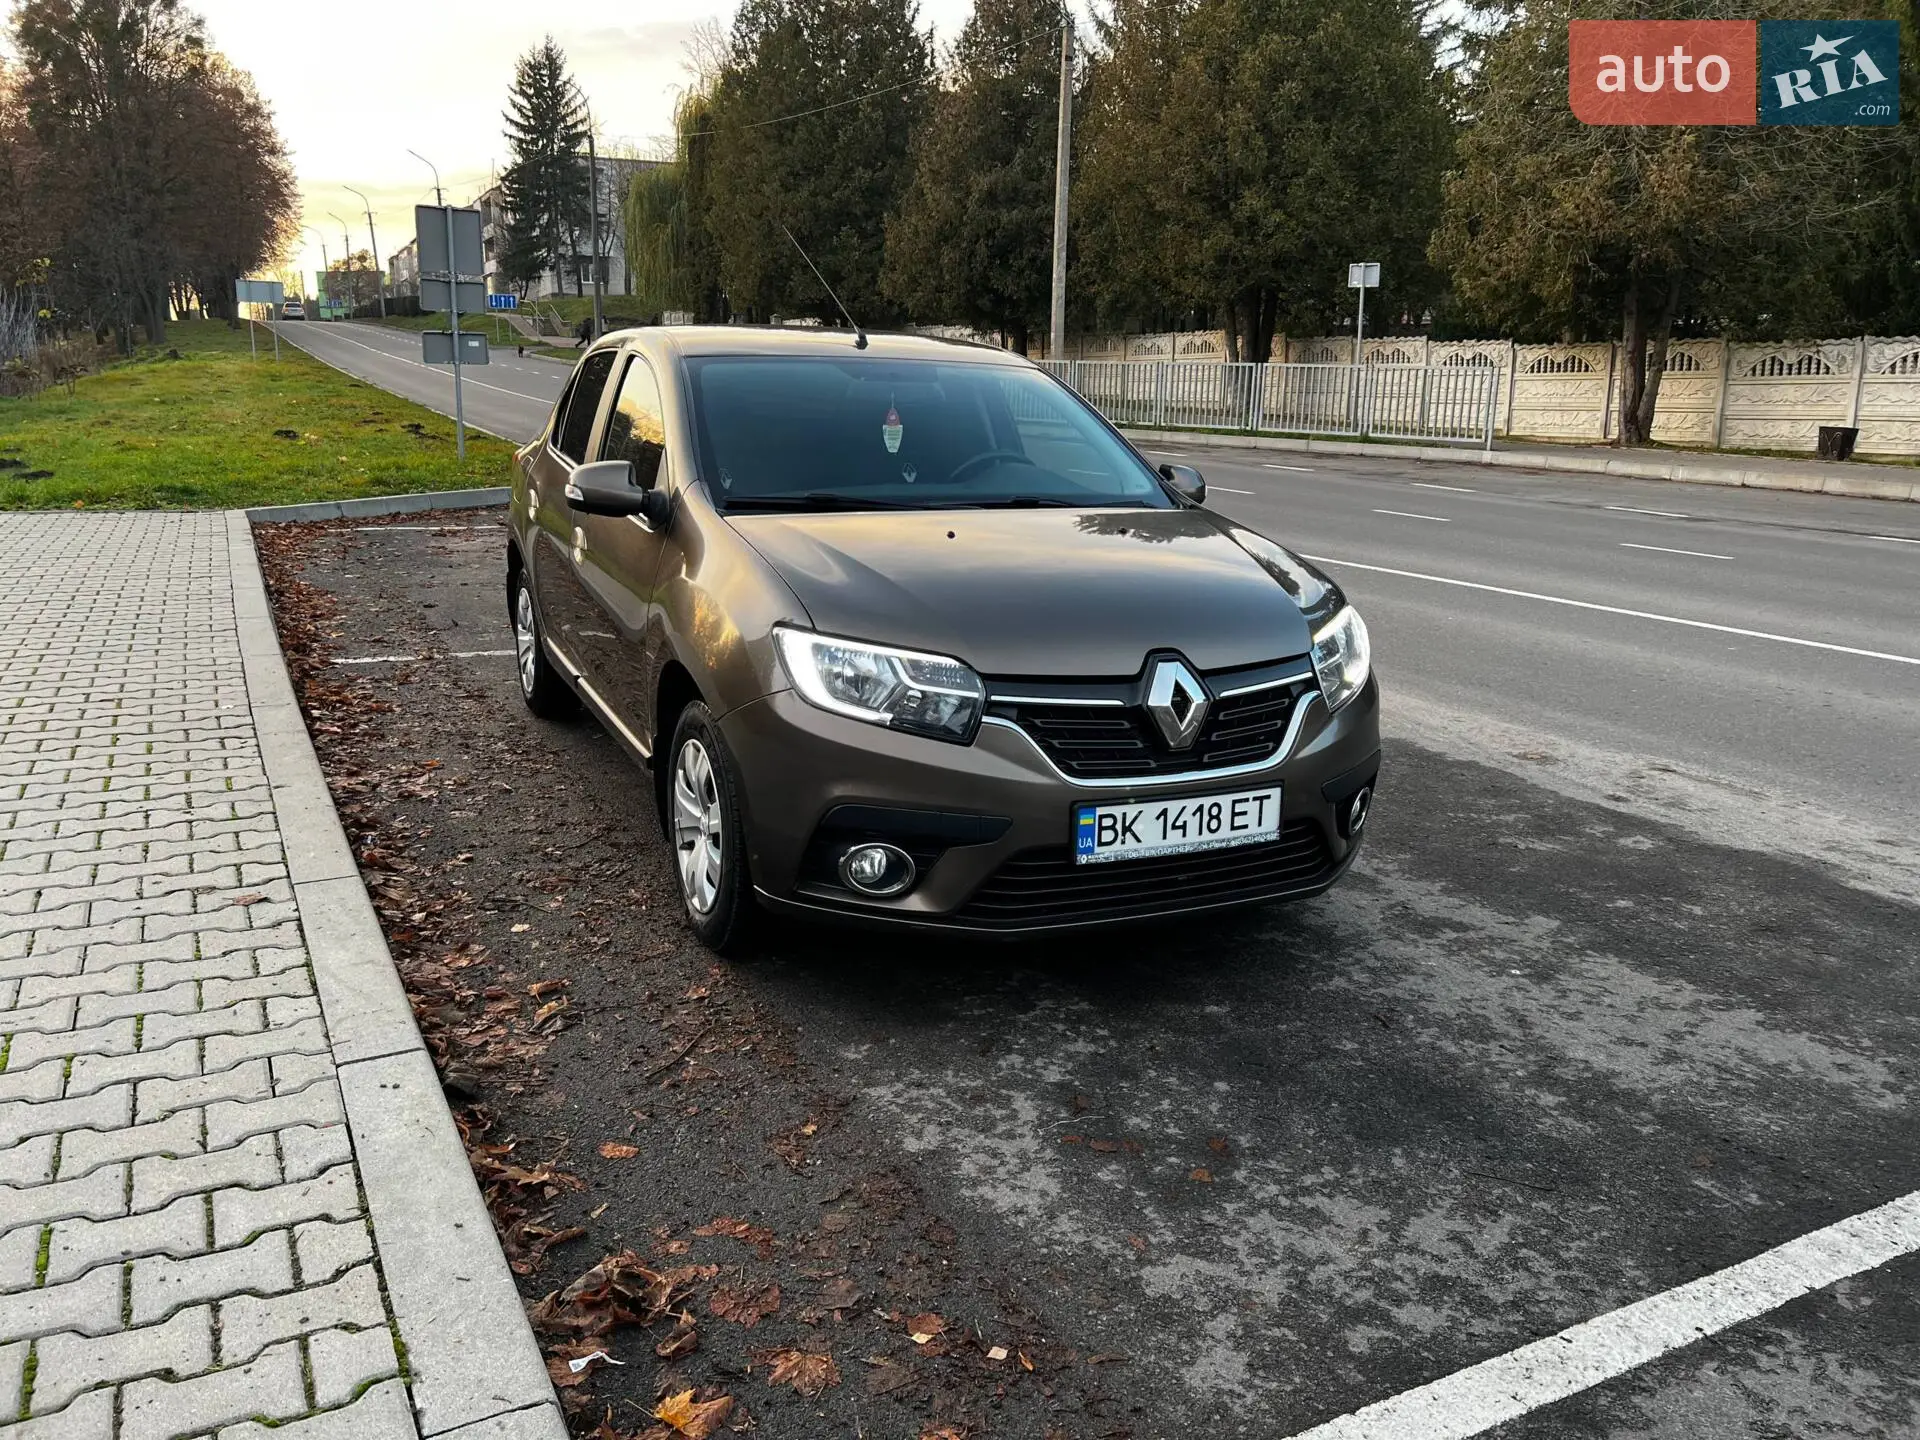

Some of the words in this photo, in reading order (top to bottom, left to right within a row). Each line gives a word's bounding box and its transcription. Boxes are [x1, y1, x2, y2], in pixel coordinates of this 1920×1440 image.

[1097, 810, 1143, 848] BK
[1155, 803, 1222, 840] 1418
[1230, 795, 1271, 831] ET
[1078, 837, 1093, 848] UA
